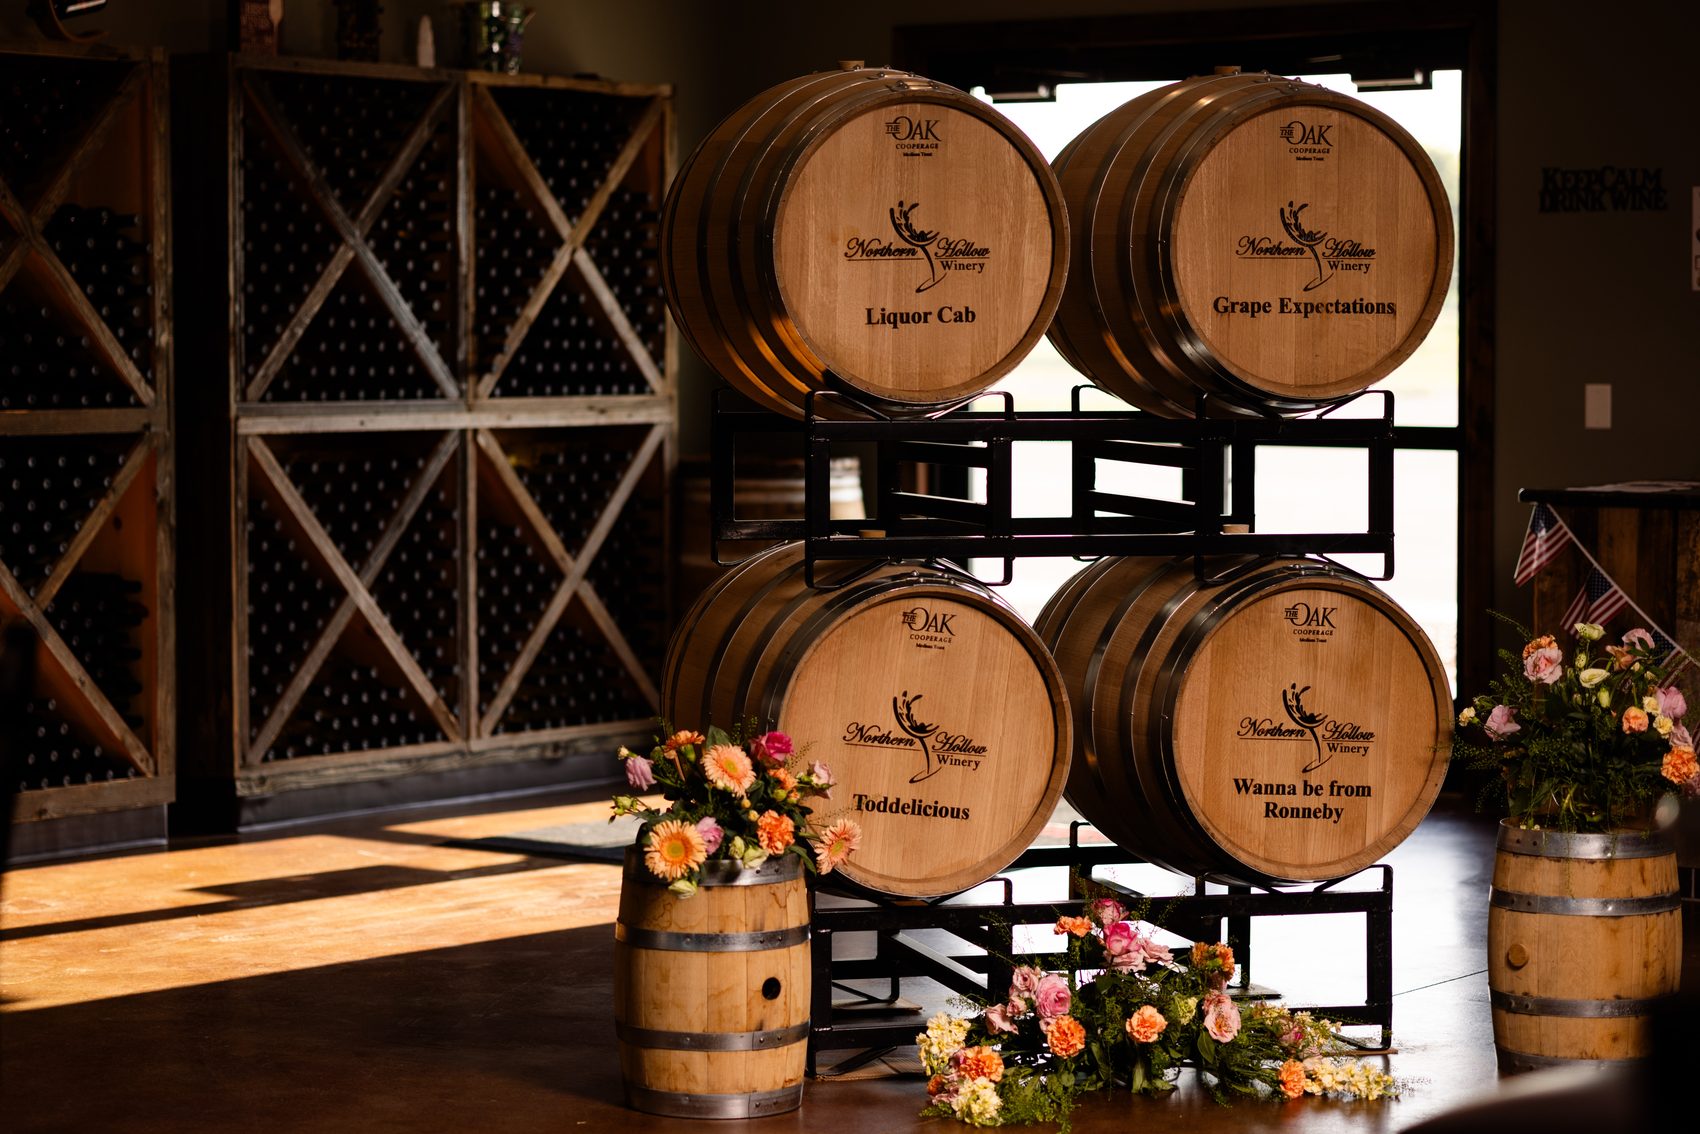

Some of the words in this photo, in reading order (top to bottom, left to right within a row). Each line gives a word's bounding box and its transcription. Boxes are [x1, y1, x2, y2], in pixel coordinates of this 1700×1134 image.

[892, 115, 942, 142] OAK
[1286, 121, 1333, 147] OAK
[1600, 165, 1664, 192] CALM
[1539, 190, 1607, 212] DRINK
[1612, 189, 1668, 211] WINE
[844, 237, 918, 258] Northern
[935, 237, 990, 258] Hollow
[1235, 236, 1306, 256] Northern
[1322, 237, 1376, 258] Hollow
[940, 260, 985, 274] Winery
[1327, 260, 1371, 274] Winery
[865, 307, 932, 329] Liquor
[937, 306, 976, 324] Cab
[1213, 296, 1272, 318] Grape
[1278, 297, 1396, 318] Expectations
[907, 607, 957, 636] OAK
[1289, 602, 1337, 629] OAK
[910, 633, 952, 643] COOPERAGE
[842, 721, 916, 747] Northern
[931, 731, 988, 755] Hollow
[1236, 716, 1306, 738] Northern
[1321, 720, 1375, 741] Hollow
[1327, 742, 1369, 757] Winery
[936, 754, 981, 771] Winery
[1233, 778, 1297, 796] Wanna
[1303, 779, 1324, 797] be
[1329, 780, 1372, 797] from
[853, 793, 970, 820] Toddelicious
[1264, 801, 1344, 824] Ronneby
